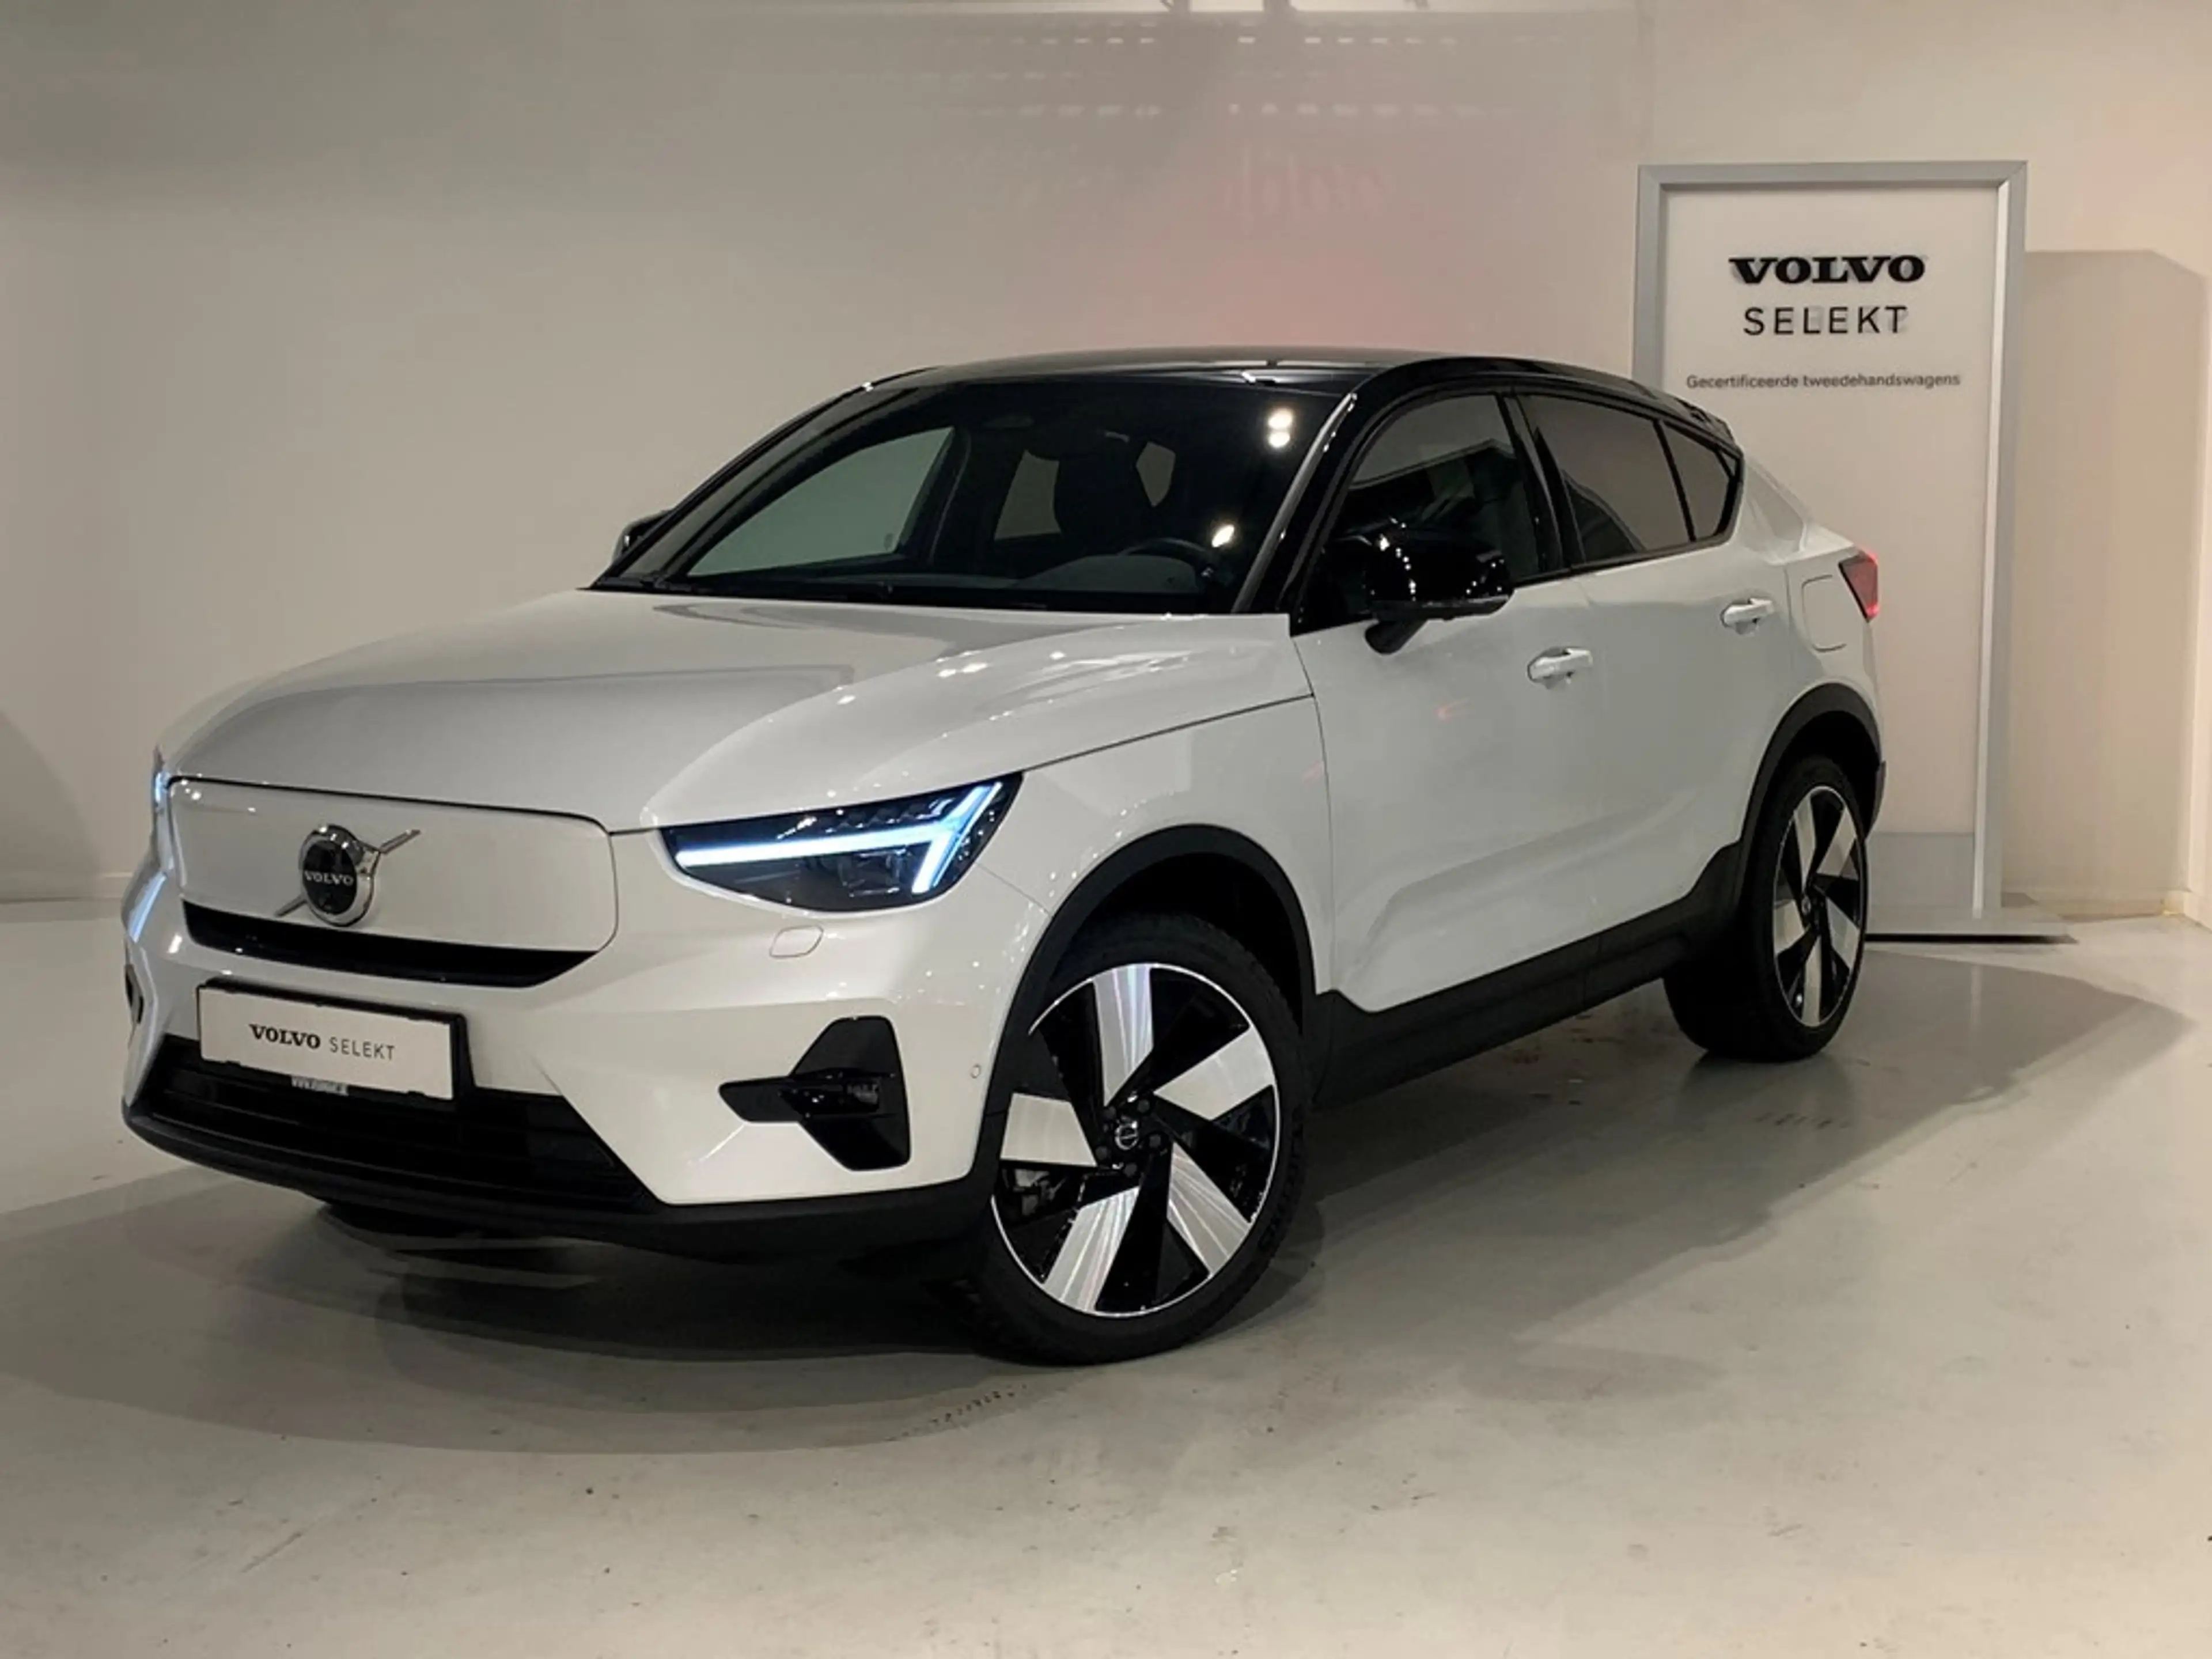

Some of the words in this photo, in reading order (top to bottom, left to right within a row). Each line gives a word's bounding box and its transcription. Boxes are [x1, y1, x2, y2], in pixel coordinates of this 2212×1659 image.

[1729, 255, 1925, 283] VOLVO
[1744, 306, 1907, 335] SELEKT
[1687, 374, 1798, 389] Gecertificeerde
[1804, 374, 1960, 389] tweedehandswagens
[305, 871, 354, 886] VOLVO
[249, 1024, 321, 1050] VOLVO
[329, 1037, 395, 1060] SELEKT
